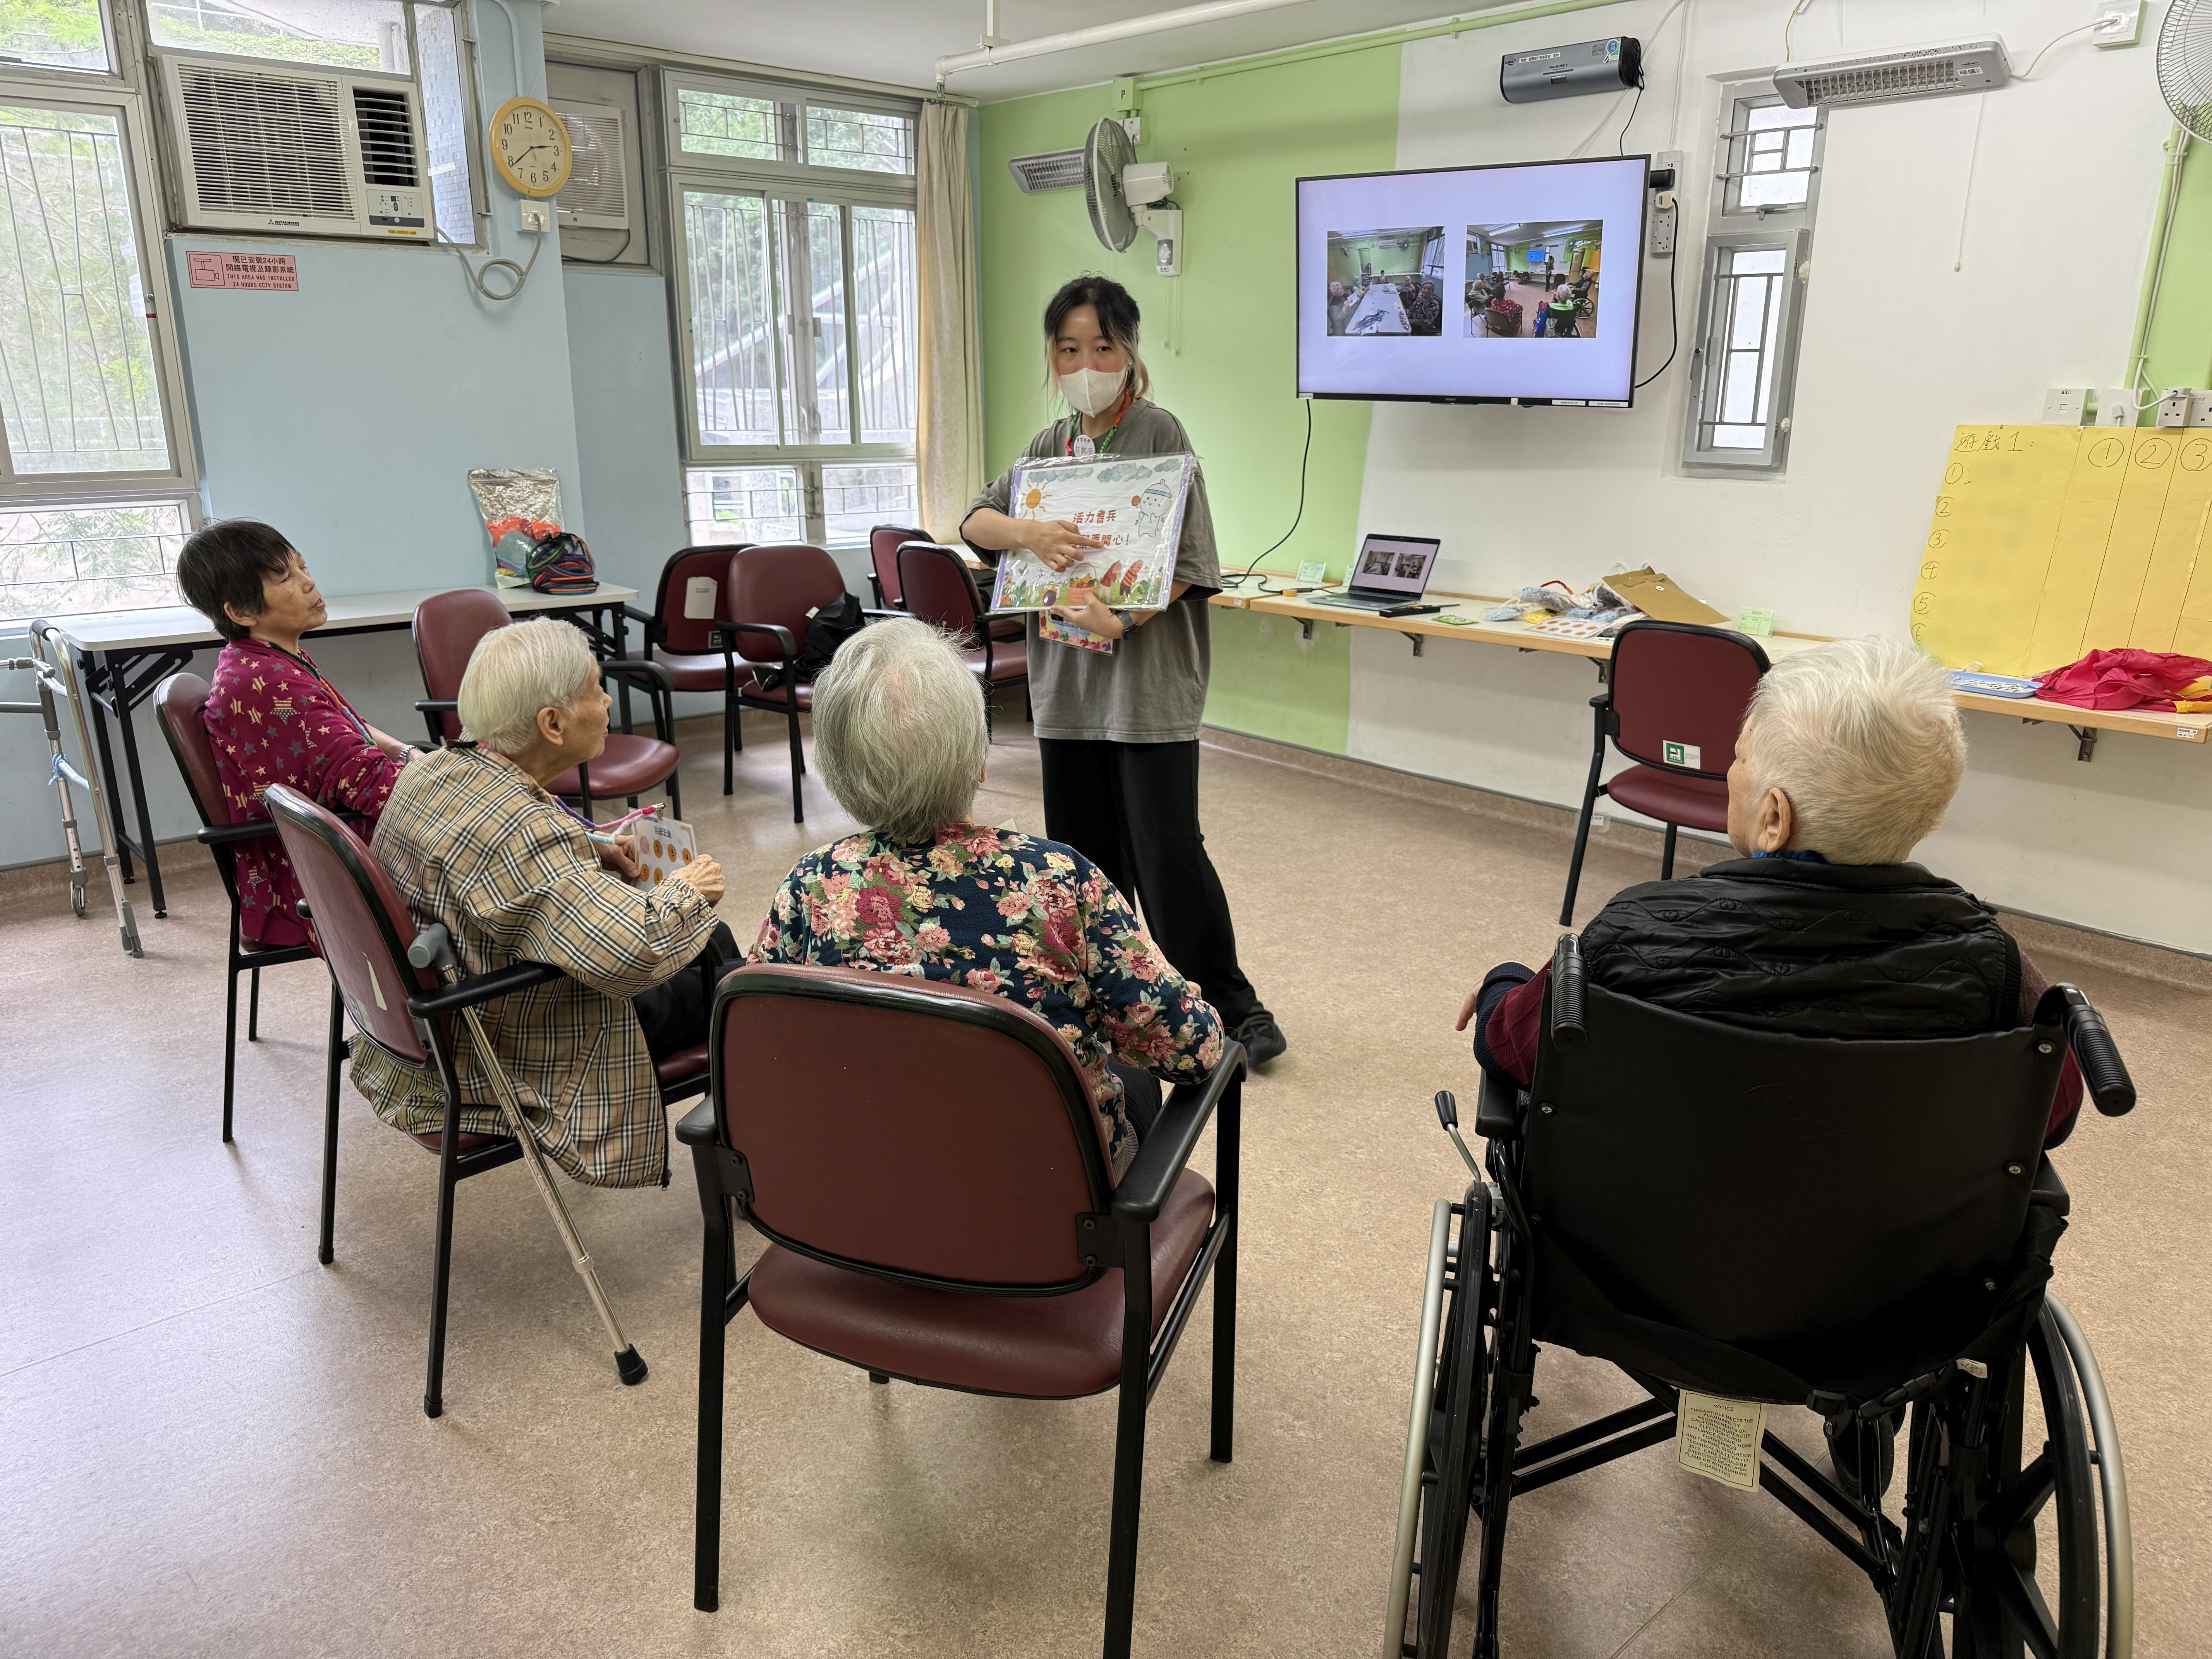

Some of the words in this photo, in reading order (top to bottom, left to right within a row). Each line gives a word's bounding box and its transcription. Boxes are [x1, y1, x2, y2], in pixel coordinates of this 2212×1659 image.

[1121, 90, 1125, 100] P
[513, 113, 519, 124] 11
[524, 112, 532, 123] 12
[539, 117, 542, 128] 1
[504, 124, 512, 135] 10
[549, 129, 555, 140] 2
[502, 139, 508, 150] 9
[553, 145, 559, 156] 3
[508, 156, 514, 167] 8
[551, 162, 556, 172] 4
[518, 168, 523, 179] 7
[531, 172, 536, 184] 6
[543, 171, 549, 182] 5
[232, 256, 285, 265] 現已安裝24小時
[226, 264, 294, 273] 閉路電視及錄影系統
[1072, 510, 1116, 524] 活力耆兵
[1698, 1416, 1737, 1432] REQUIREMENTS
[1704, 1414, 1740, 1428] FLAMMABILITY
[1687, 1425, 1716, 1437] APPLIANCE
[1692, 1418, 1722, 1430] CALIFORNIA
[1723, 1427, 1743, 1438] BUREAU
[1699, 1424, 1730, 1438] ELECTRONIC
[1698, 1437, 1720, 1449] THERMAL
[1722, 1446, 1751, 1458] INSULATION
[1702, 1434, 1736, 1450] FURNISHINGS
[1687, 1438, 1714, 1451] TECHNICAL
[1716, 1449, 1739, 1461] BULLETIN
[1688, 1448, 1717, 1461] EXERCISED
[1717, 1459, 1731, 1468] NEAR
[1704, 1449, 1717, 1457] CARE
[1718, 1456, 1739, 1465] SHOULD
[1685, 1452, 1701, 1460] FLAME
[1711, 1461, 1723, 1469] WITH
[1724, 1467, 1748, 1477] BURNING
